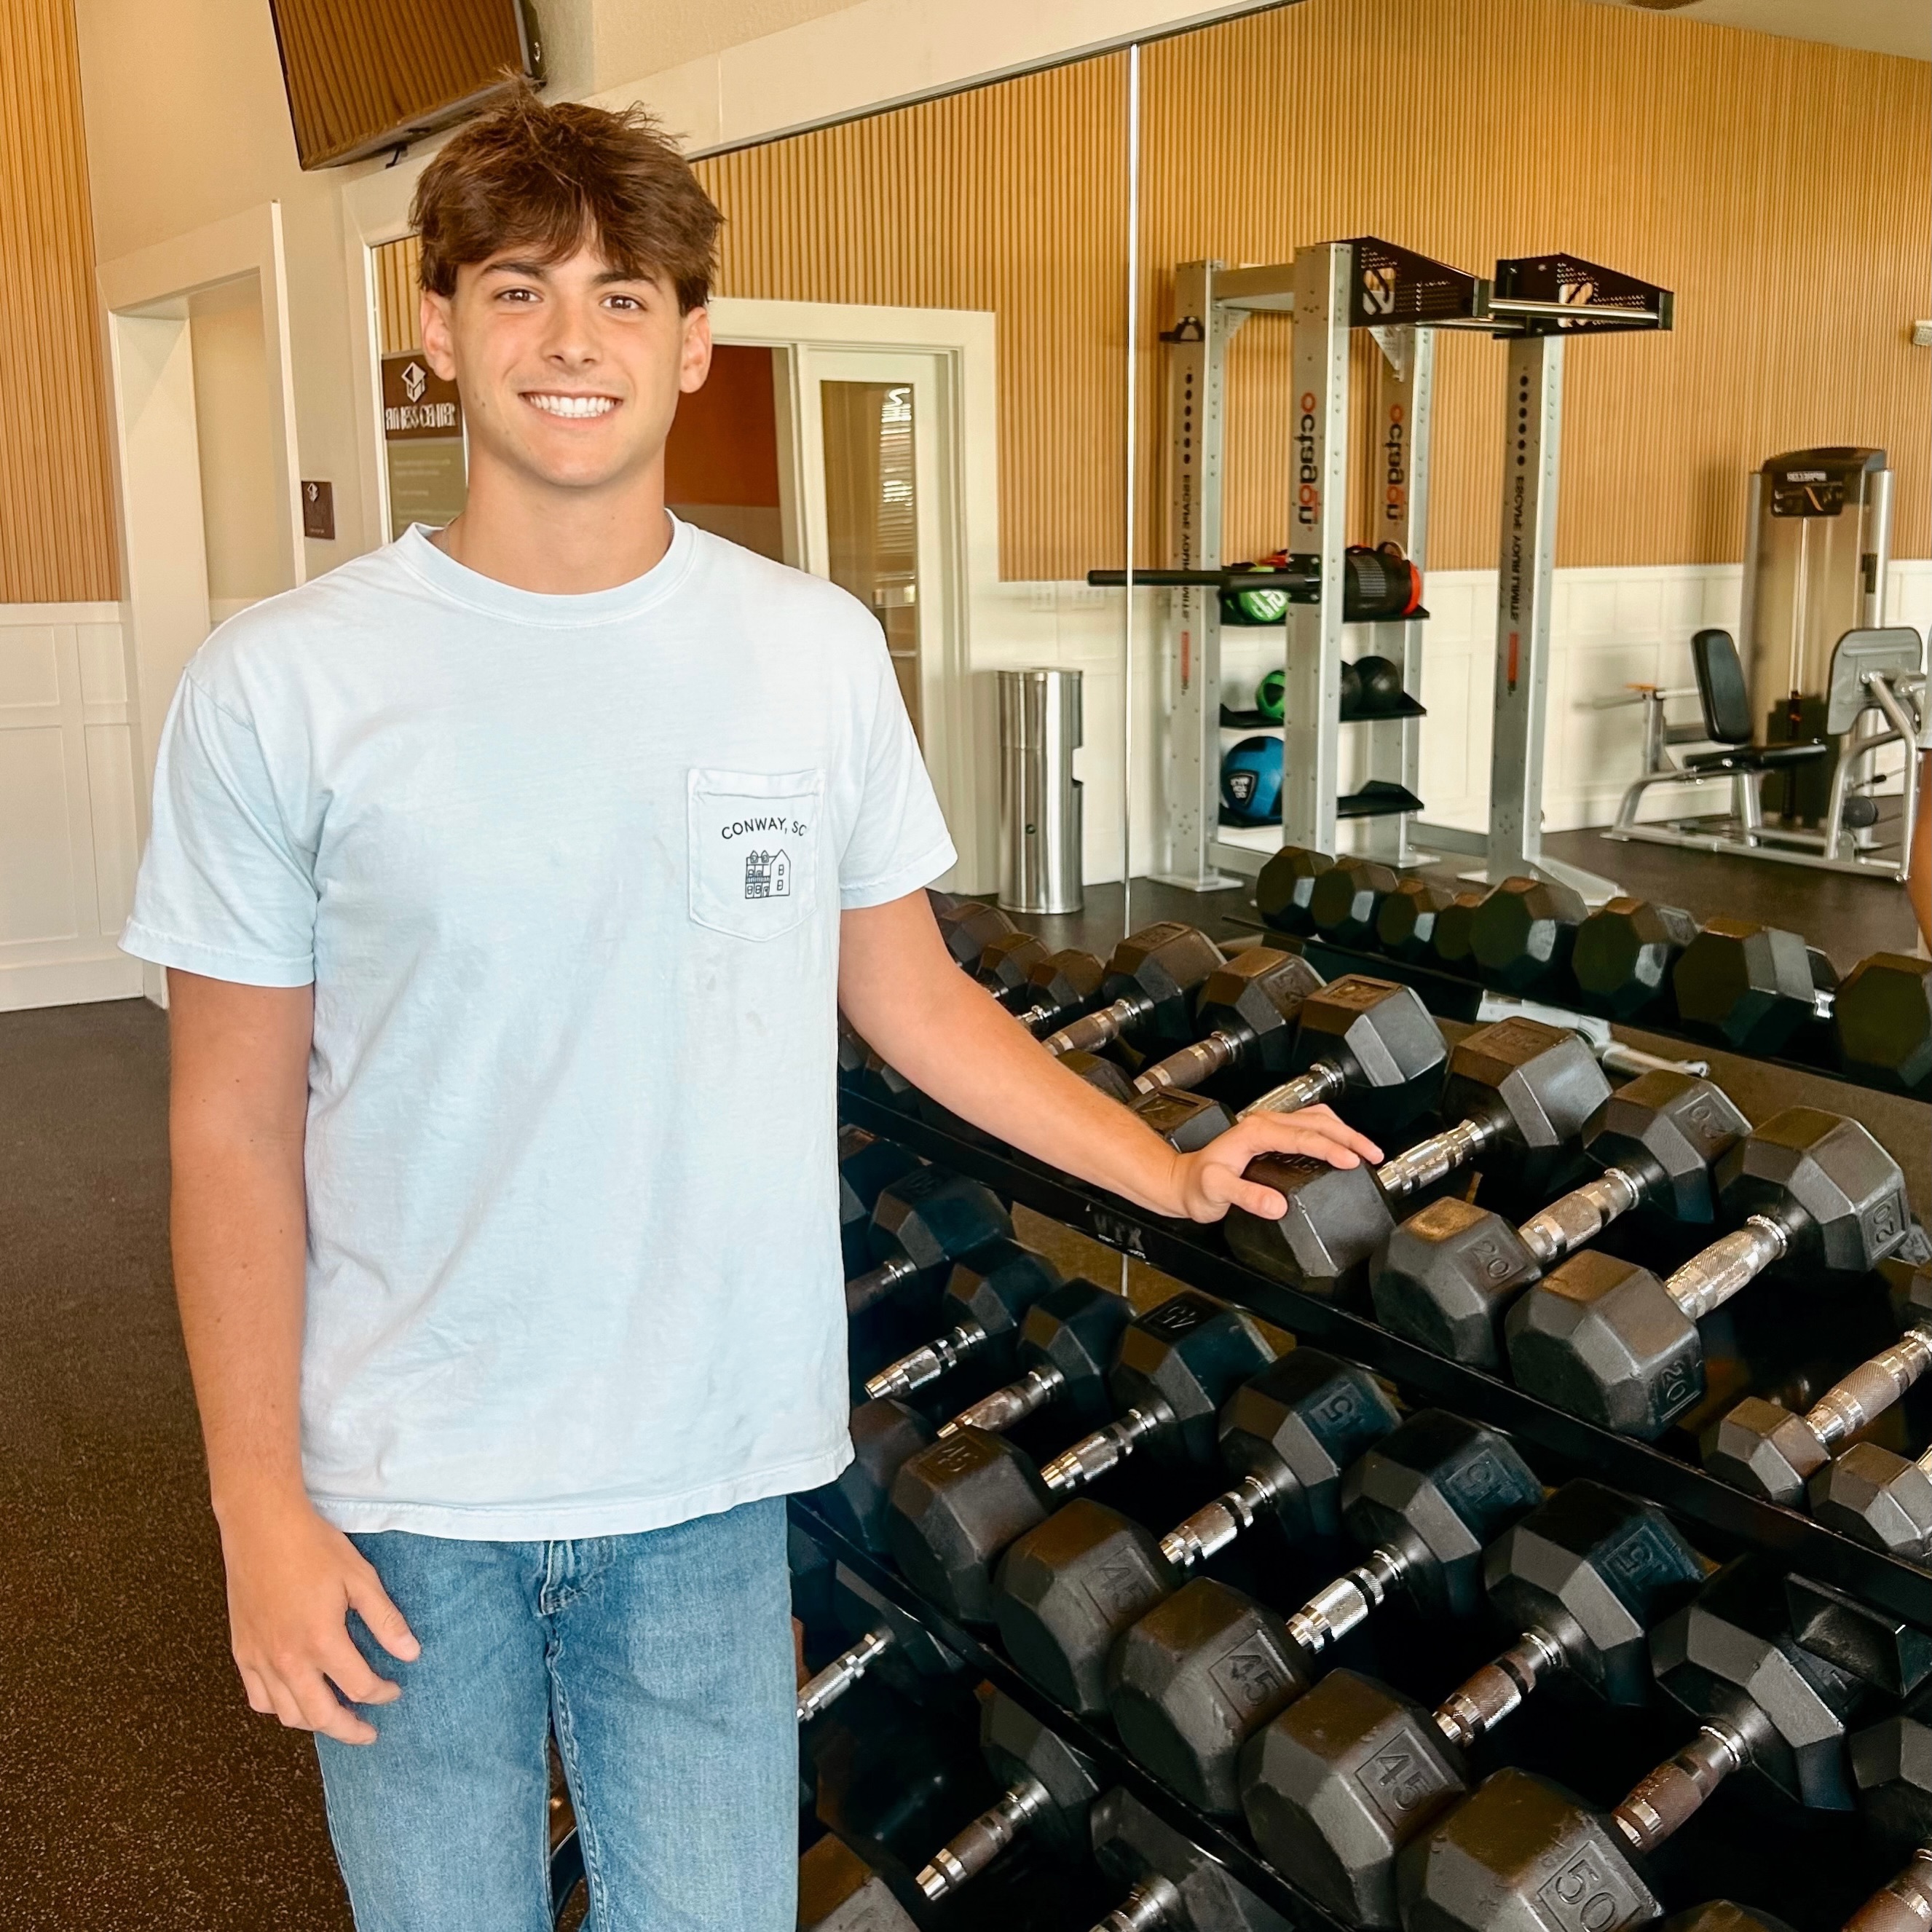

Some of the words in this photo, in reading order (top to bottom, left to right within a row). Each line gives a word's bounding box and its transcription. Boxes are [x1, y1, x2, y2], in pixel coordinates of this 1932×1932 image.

[722, 817, 787, 839] CONWAY,
[792, 821, 807, 837] SC
[1873, 1204, 1894, 1244] 20
[1471, 1240, 1511, 1280] 20
[1662, 1360, 1687, 1402] 20
[1099, 1567, 1148, 1614] 45
[1227, 1654, 1280, 1706] 45
[1375, 1754, 1432, 1811] 45
[1555, 1858, 1617, 1932] 50
